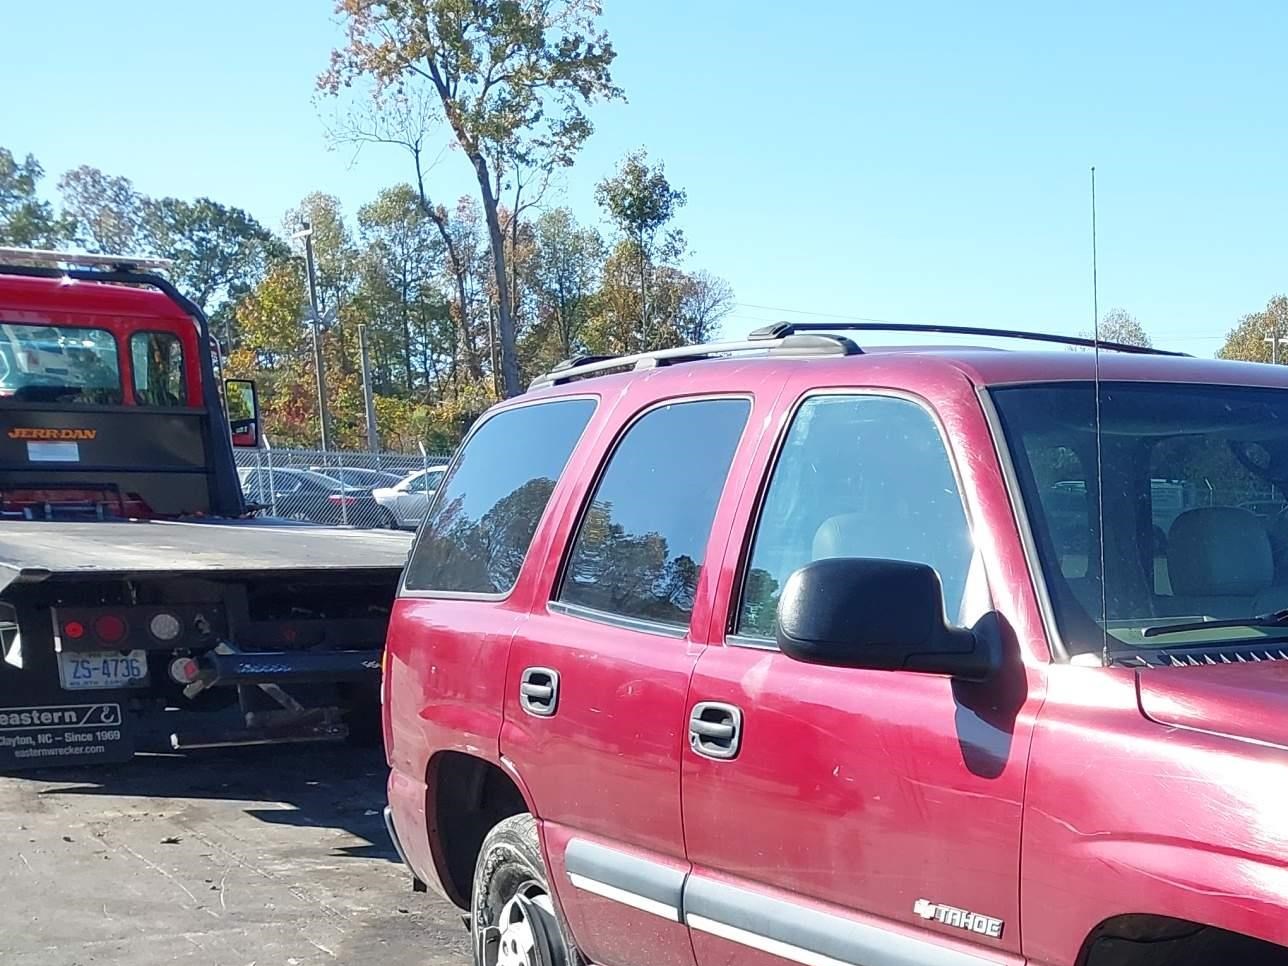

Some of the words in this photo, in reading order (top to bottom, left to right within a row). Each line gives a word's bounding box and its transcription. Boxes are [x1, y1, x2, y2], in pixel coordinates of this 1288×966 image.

[70, 658, 141, 679] ZS-4736
[38, 733, 53, 744] NC
[64, 731, 94, 743] Since
[96, 730, 121, 741] 1969
[14, 745, 105, 758] easternwrecker.com
[936, 904, 1005, 940] TAHOE
